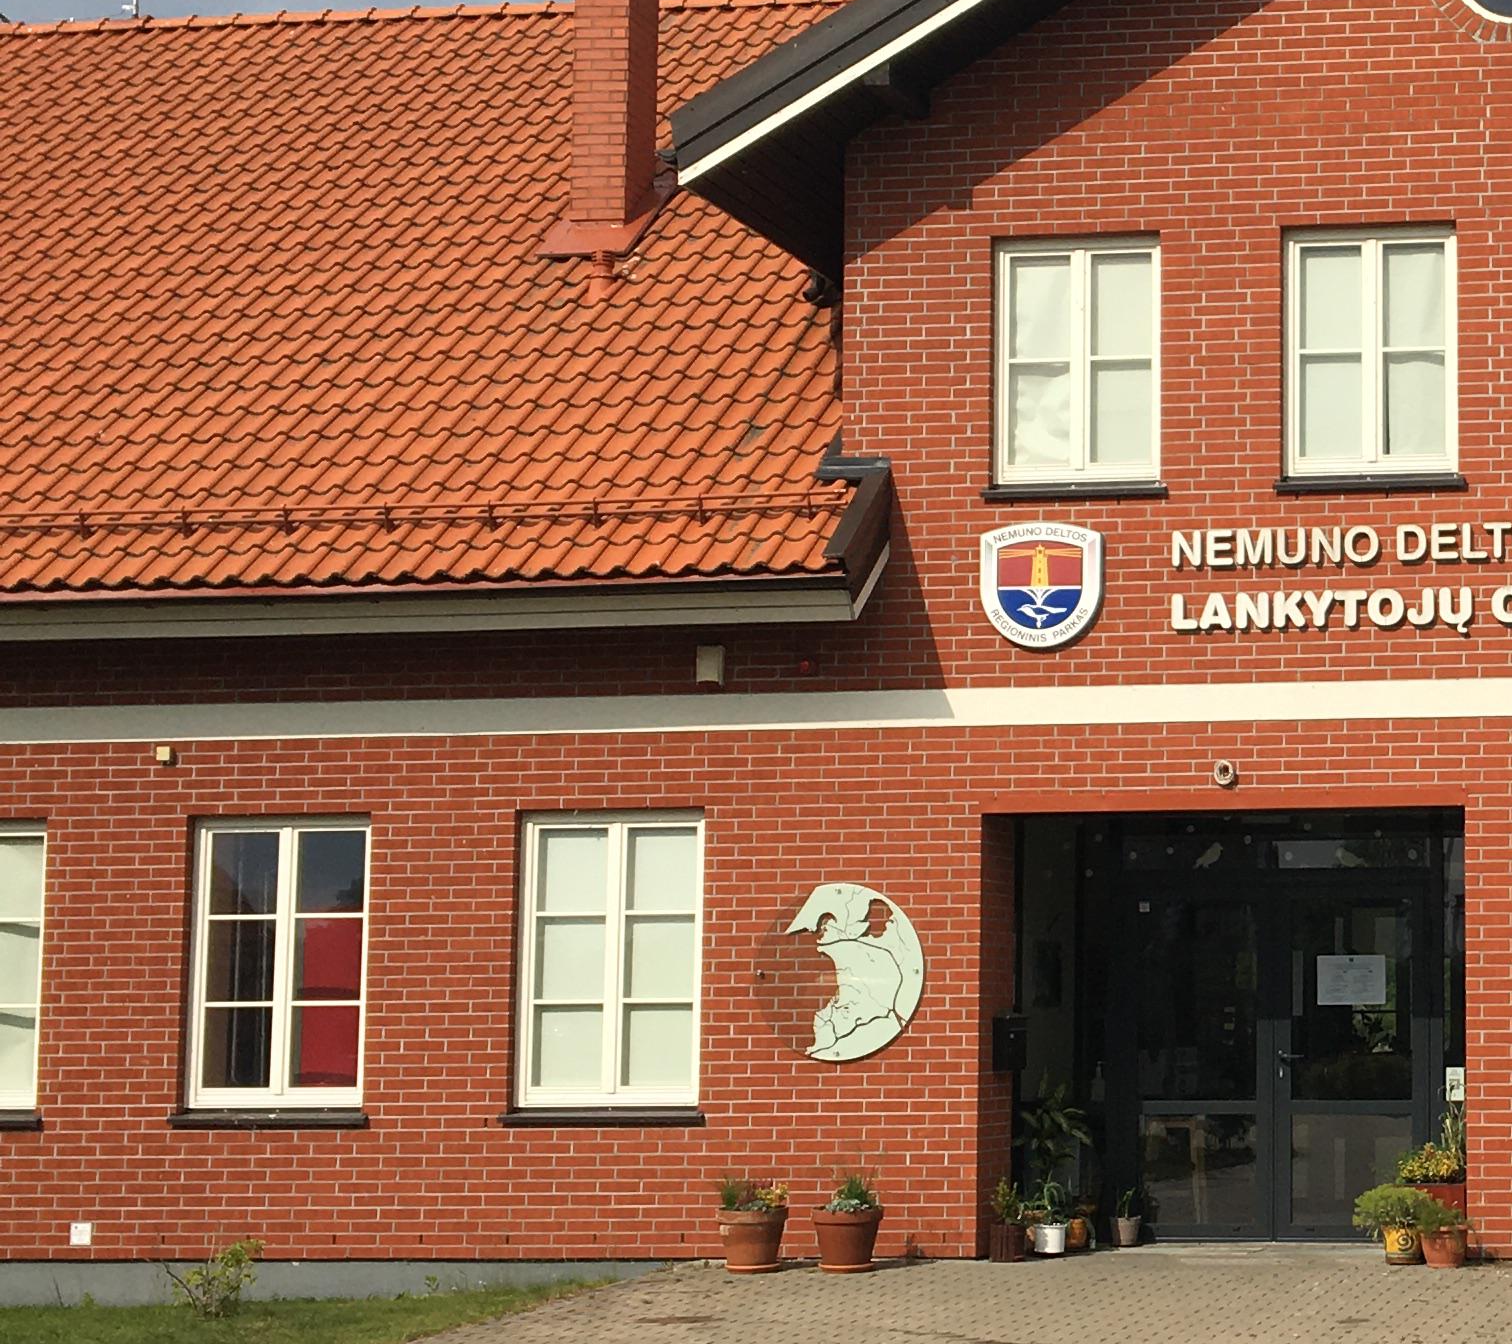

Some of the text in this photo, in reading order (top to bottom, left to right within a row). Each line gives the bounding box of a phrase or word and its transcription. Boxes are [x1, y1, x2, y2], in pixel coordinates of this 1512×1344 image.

[993, 527, 1089, 544] NEMUNO DELTOS
[1171, 526, 1380, 569] NEMUNO
[990, 607, 1089, 643] REGIONINIS PARKAS
[1171, 587, 1473, 634] LANKYTOJŲ
